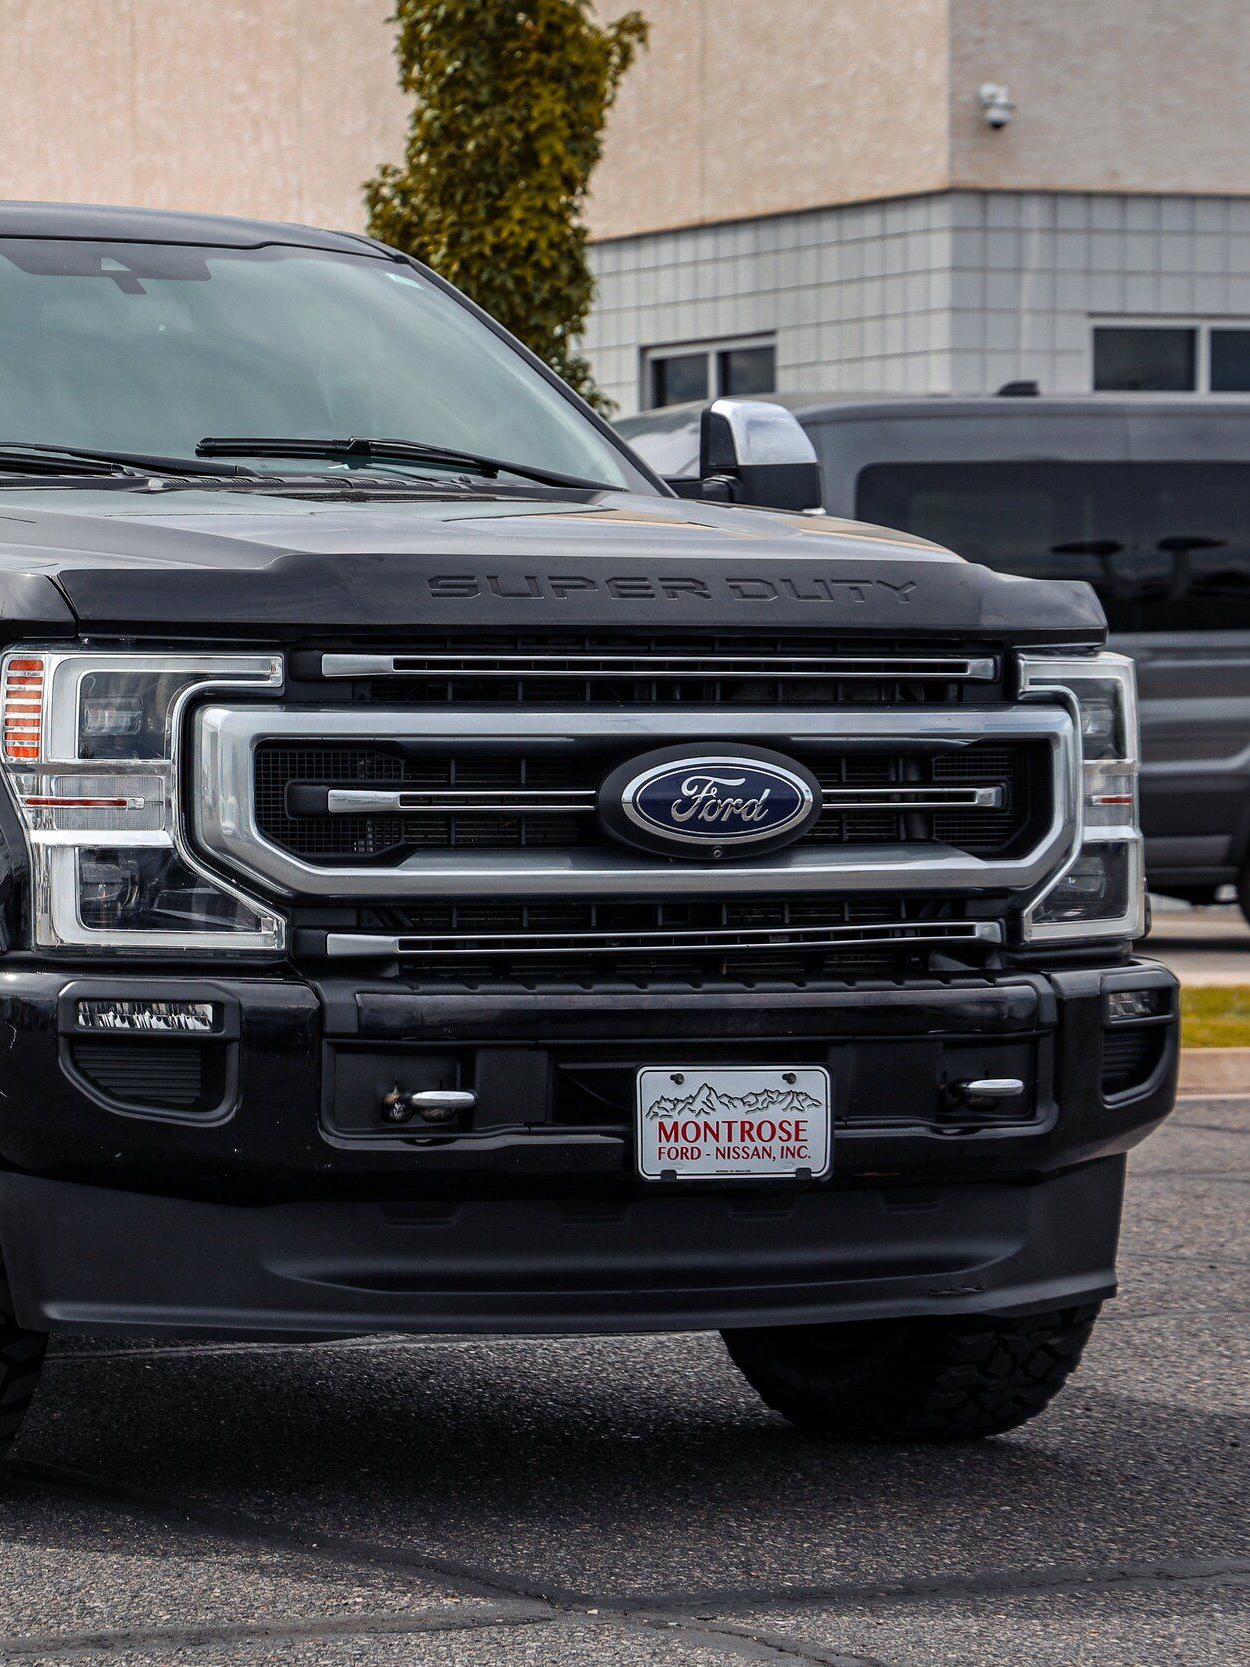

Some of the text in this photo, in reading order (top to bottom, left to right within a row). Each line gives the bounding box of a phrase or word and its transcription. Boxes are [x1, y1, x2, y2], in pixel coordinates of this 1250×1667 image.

[426, 574, 917, 604] SUPER DUTY
[671, 775, 771, 822] Ford
[657, 1119, 809, 1144] MONTROSE
[657, 1146, 701, 1161] FORD
[715, 1145, 776, 1162] NISSAN,
[779, 1145, 812, 1160] INC.
